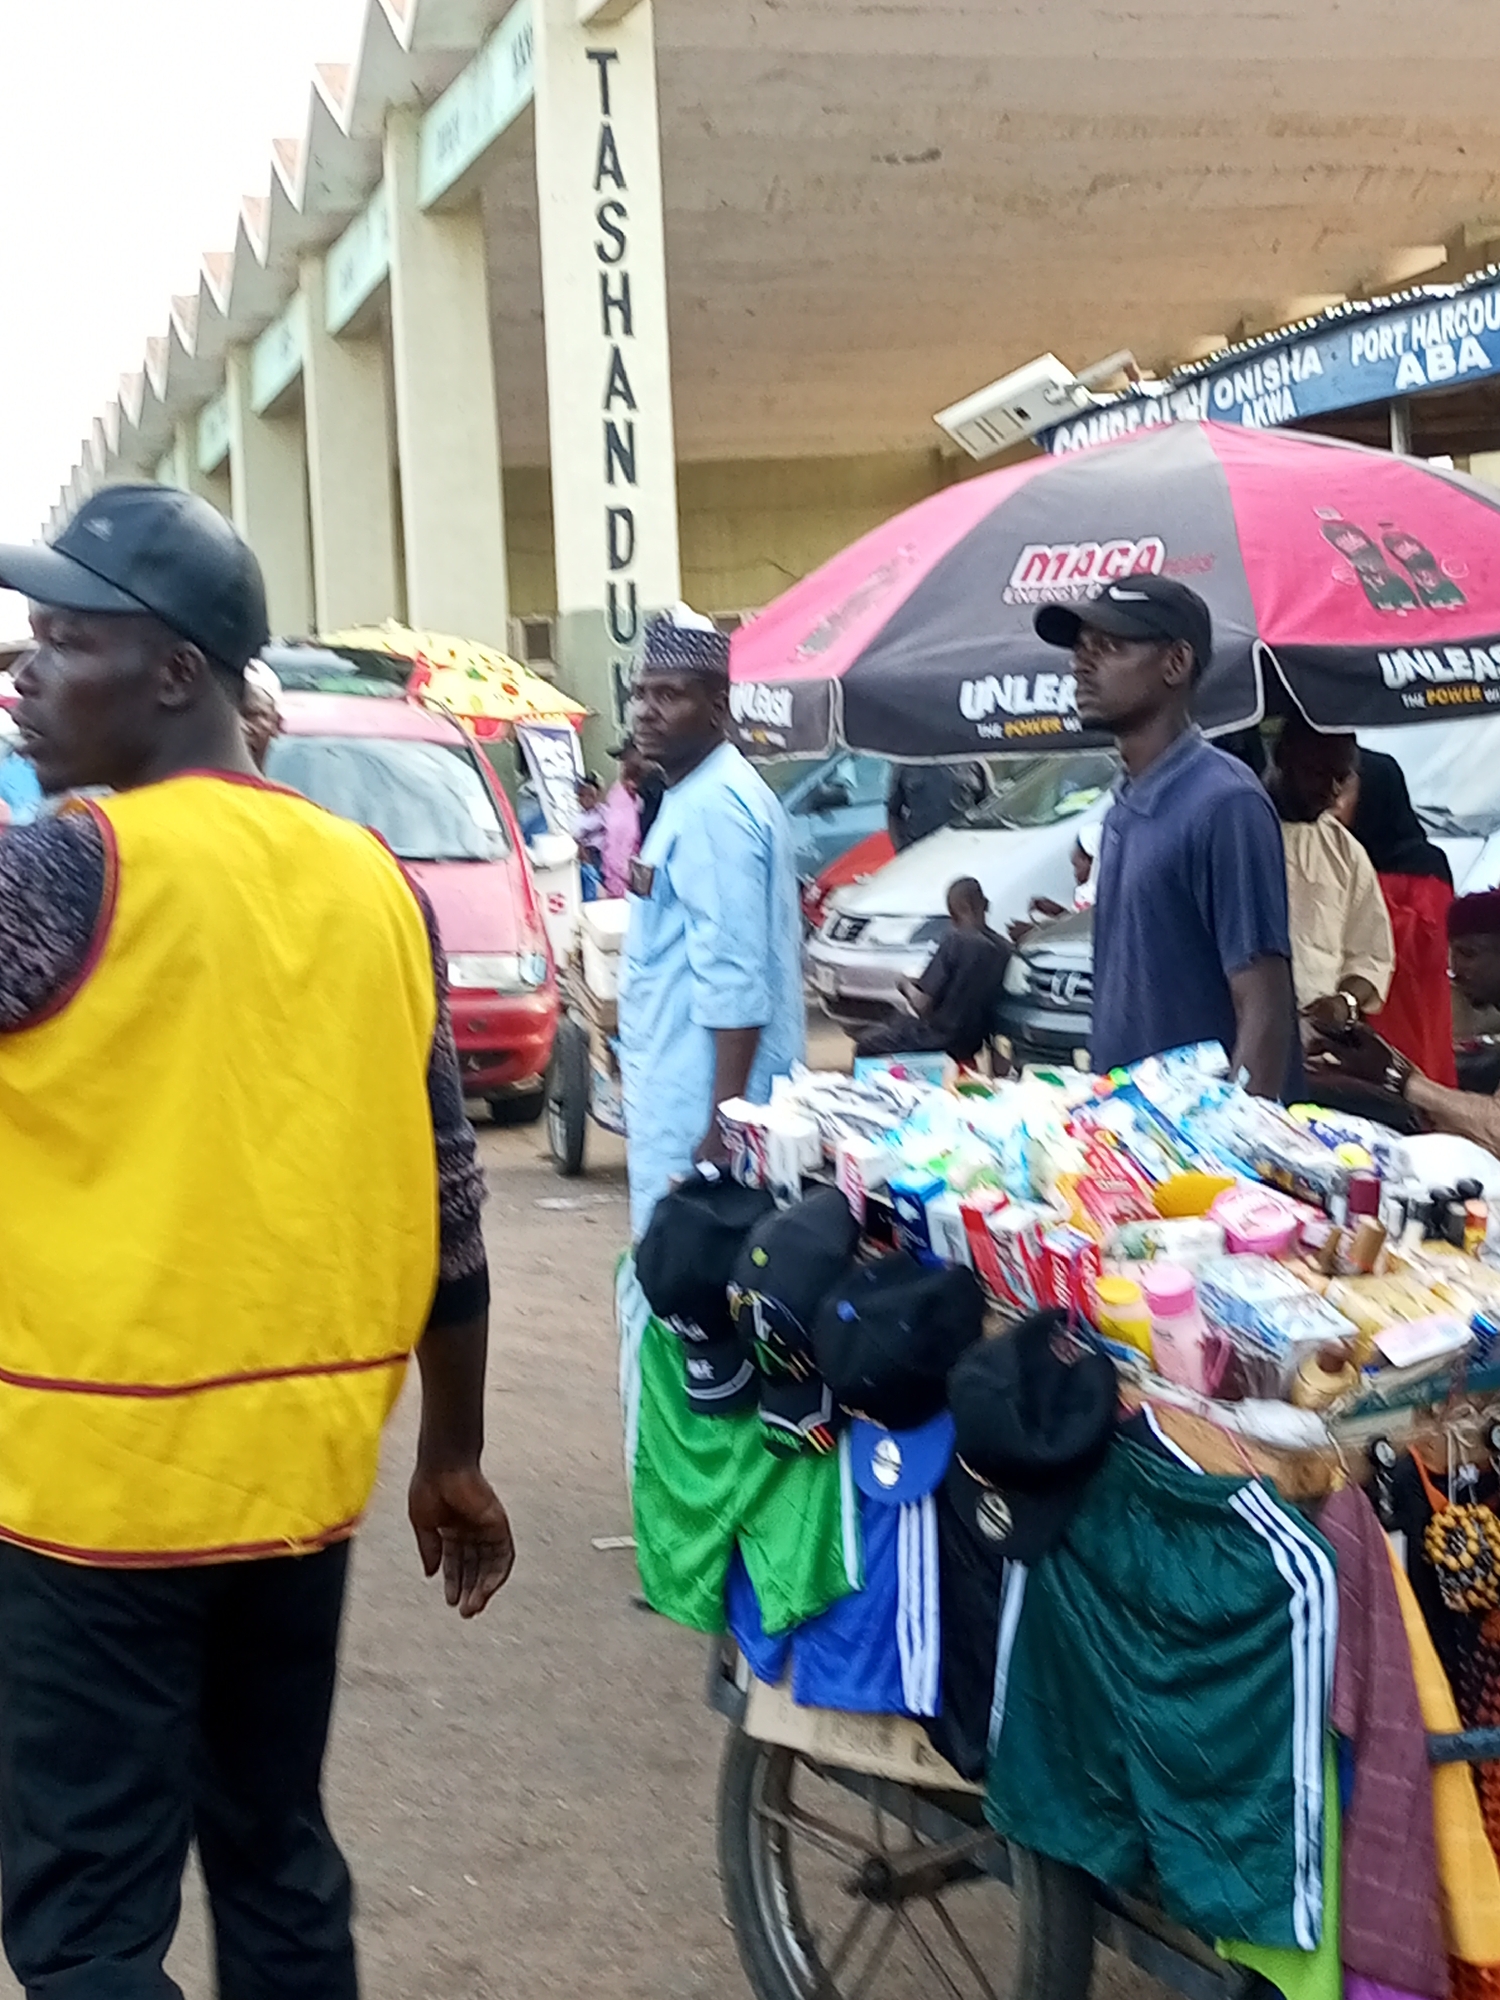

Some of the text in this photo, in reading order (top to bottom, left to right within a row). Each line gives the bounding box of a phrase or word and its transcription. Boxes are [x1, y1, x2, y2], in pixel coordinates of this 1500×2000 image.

[585, 46, 639, 488] TASHAN
[1349, 291, 1500, 367] PORT HARCOU
[1212, 345, 1324, 411] ONISHA
[1394, 335, 1493, 390] ABA
[1241, 385, 1298, 428] AKWA
[959, 672, 1081, 720] UNLEA
[1426, 684, 1483, 706] POWER
[1004, 716, 1063, 739] POWER
